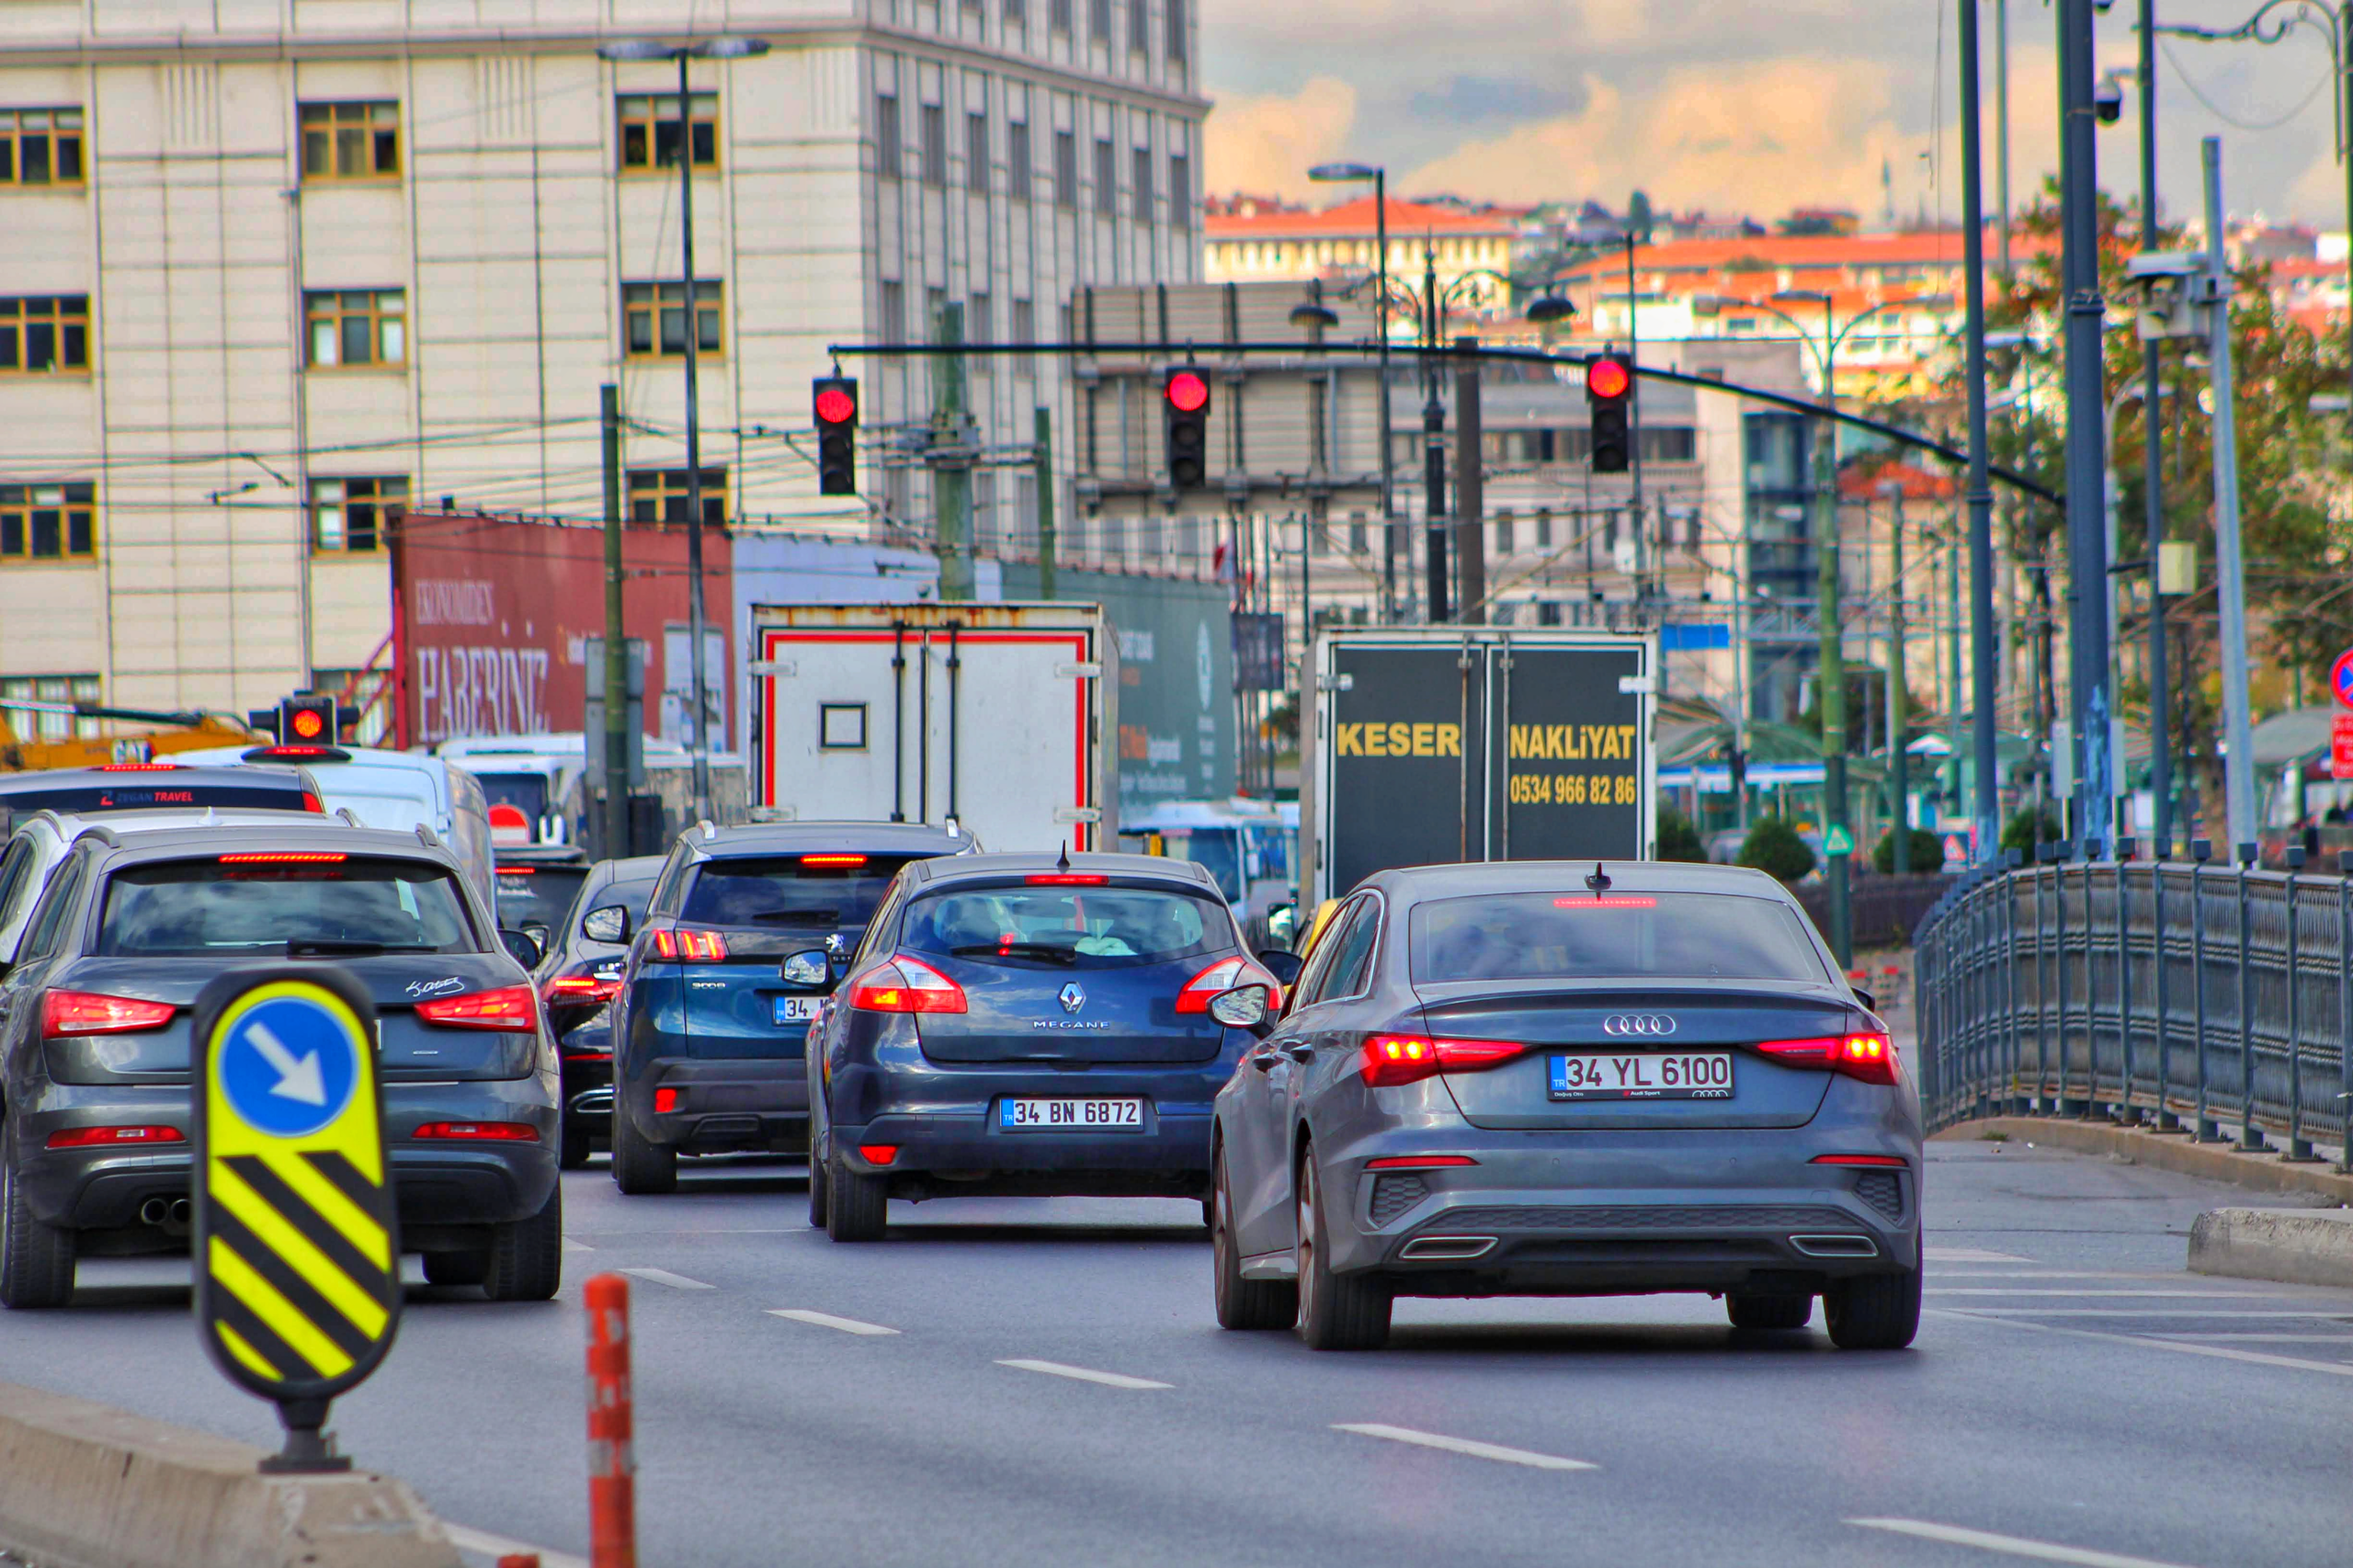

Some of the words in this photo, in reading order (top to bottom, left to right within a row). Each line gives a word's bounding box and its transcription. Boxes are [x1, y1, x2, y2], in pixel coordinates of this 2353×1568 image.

[1337, 722, 1461, 757] KESER
[154, 791, 193, 802] TRAVEL
[1510, 775, 1552, 804] 0534
[1555, 775, 1586, 804] 966
[1590, 775, 1611, 804] 82
[1615, 775, 1637, 804] 86
[787, 999, 808, 1017] 34
[1033, 1020, 1110, 1030] MEGANE
[1553, 1078, 1566, 1088] TR
[1567, 1058, 1602, 1087] 34
[1612, 1057, 1652, 1086] YL
[1661, 1056, 1729, 1086] 6100
[1015, 1102, 1040, 1124] 34
[1050, 1102, 1074, 1124] BN
[1085, 1102, 1137, 1124] 6872
